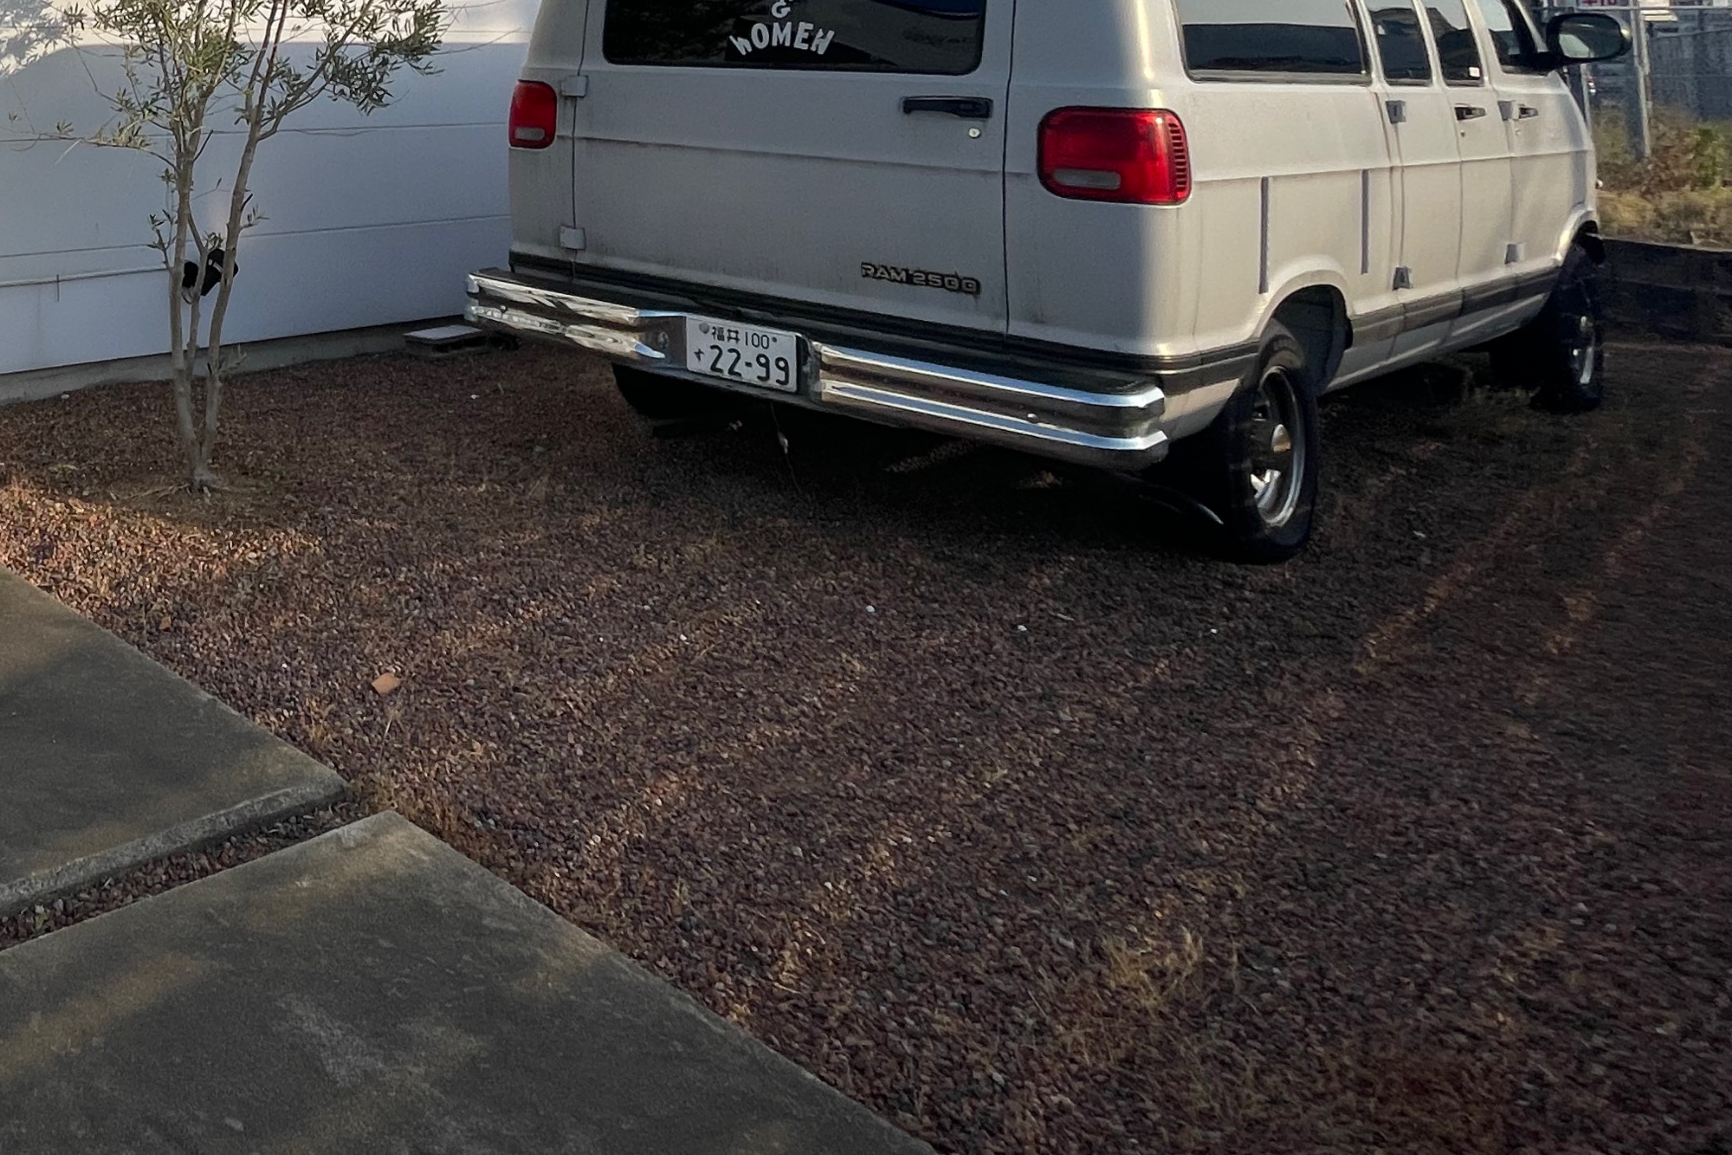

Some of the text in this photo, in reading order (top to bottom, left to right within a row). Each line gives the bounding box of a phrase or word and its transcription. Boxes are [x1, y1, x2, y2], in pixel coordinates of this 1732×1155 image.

[729, 21, 835, 55] WOMEN
[861, 262, 980, 294] RAM 2500
[711, 326, 770, 349] 福井 100
[709, 344, 790, 385] 22-99
